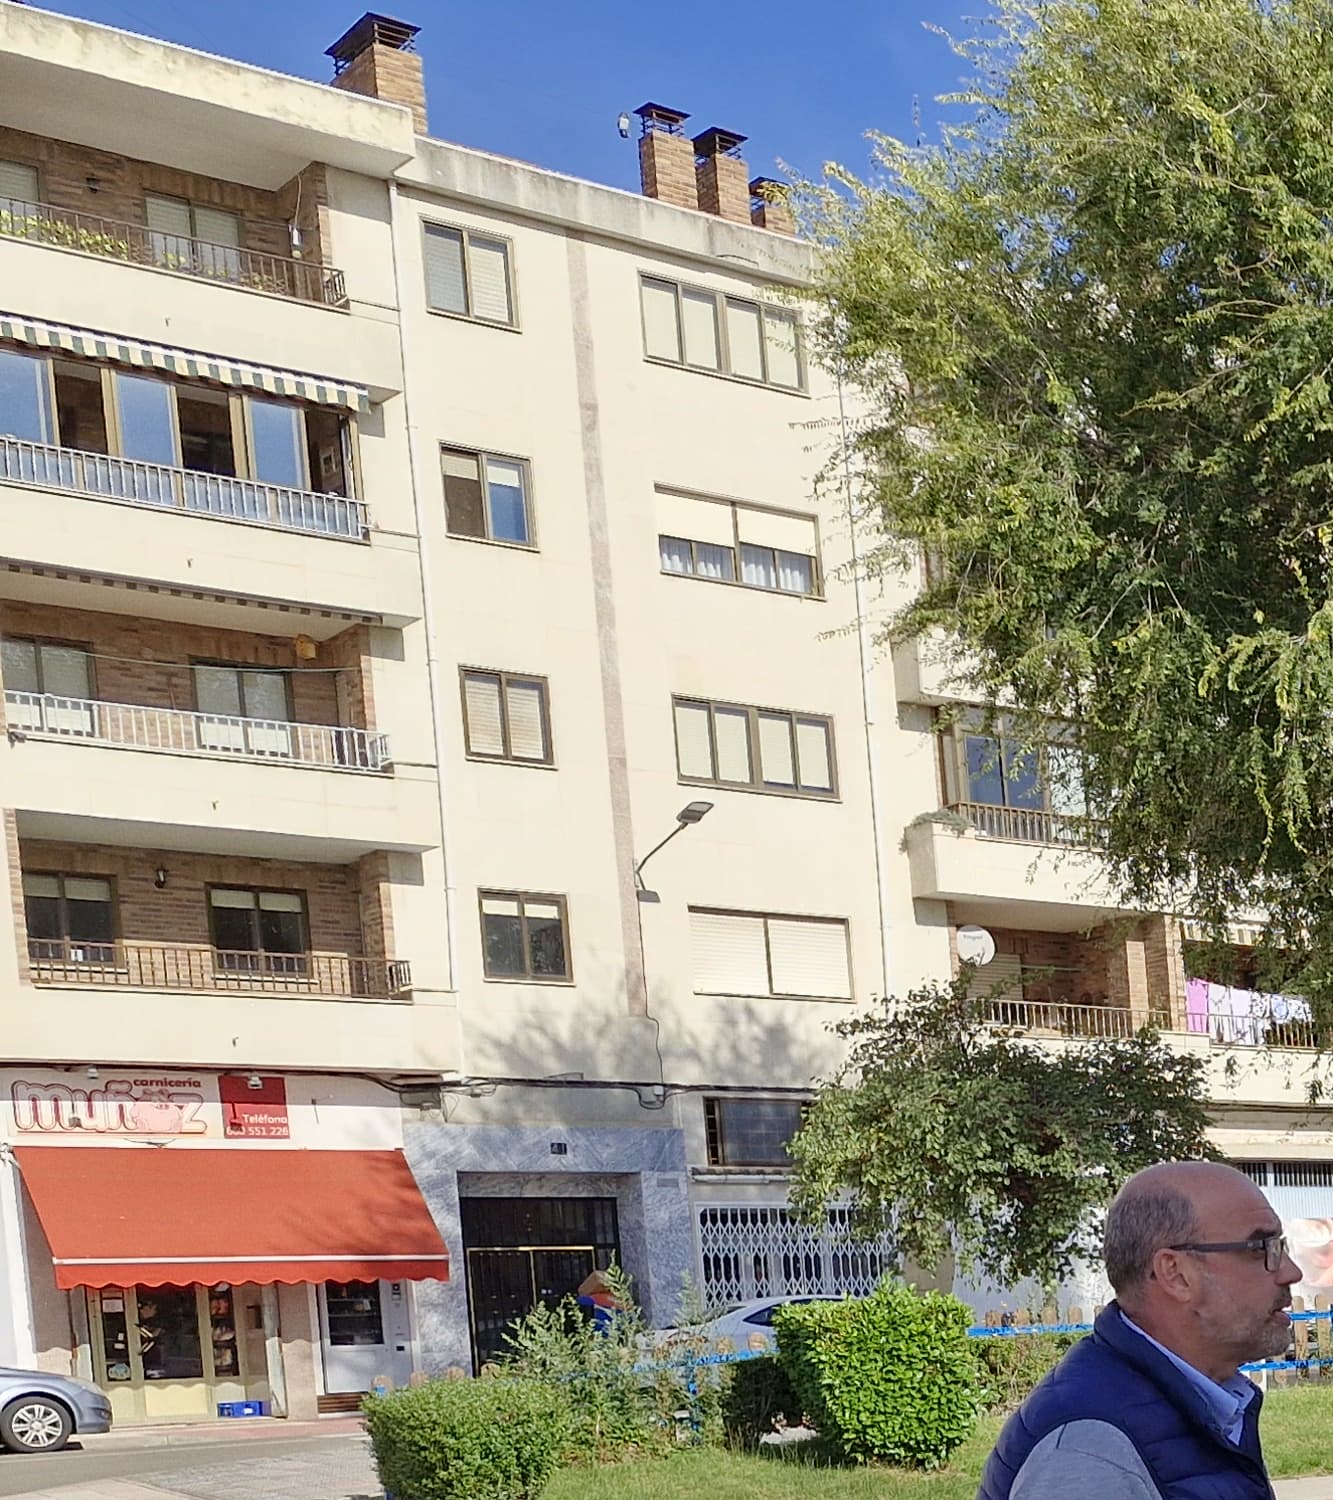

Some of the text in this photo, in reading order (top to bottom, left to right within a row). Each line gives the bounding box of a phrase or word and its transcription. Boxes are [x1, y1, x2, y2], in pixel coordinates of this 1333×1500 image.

[133, 1077, 201, 1088] carnicería
[242, 1113, 288, 1124] Teléfono
[248, 1126, 267, 1136] 551
